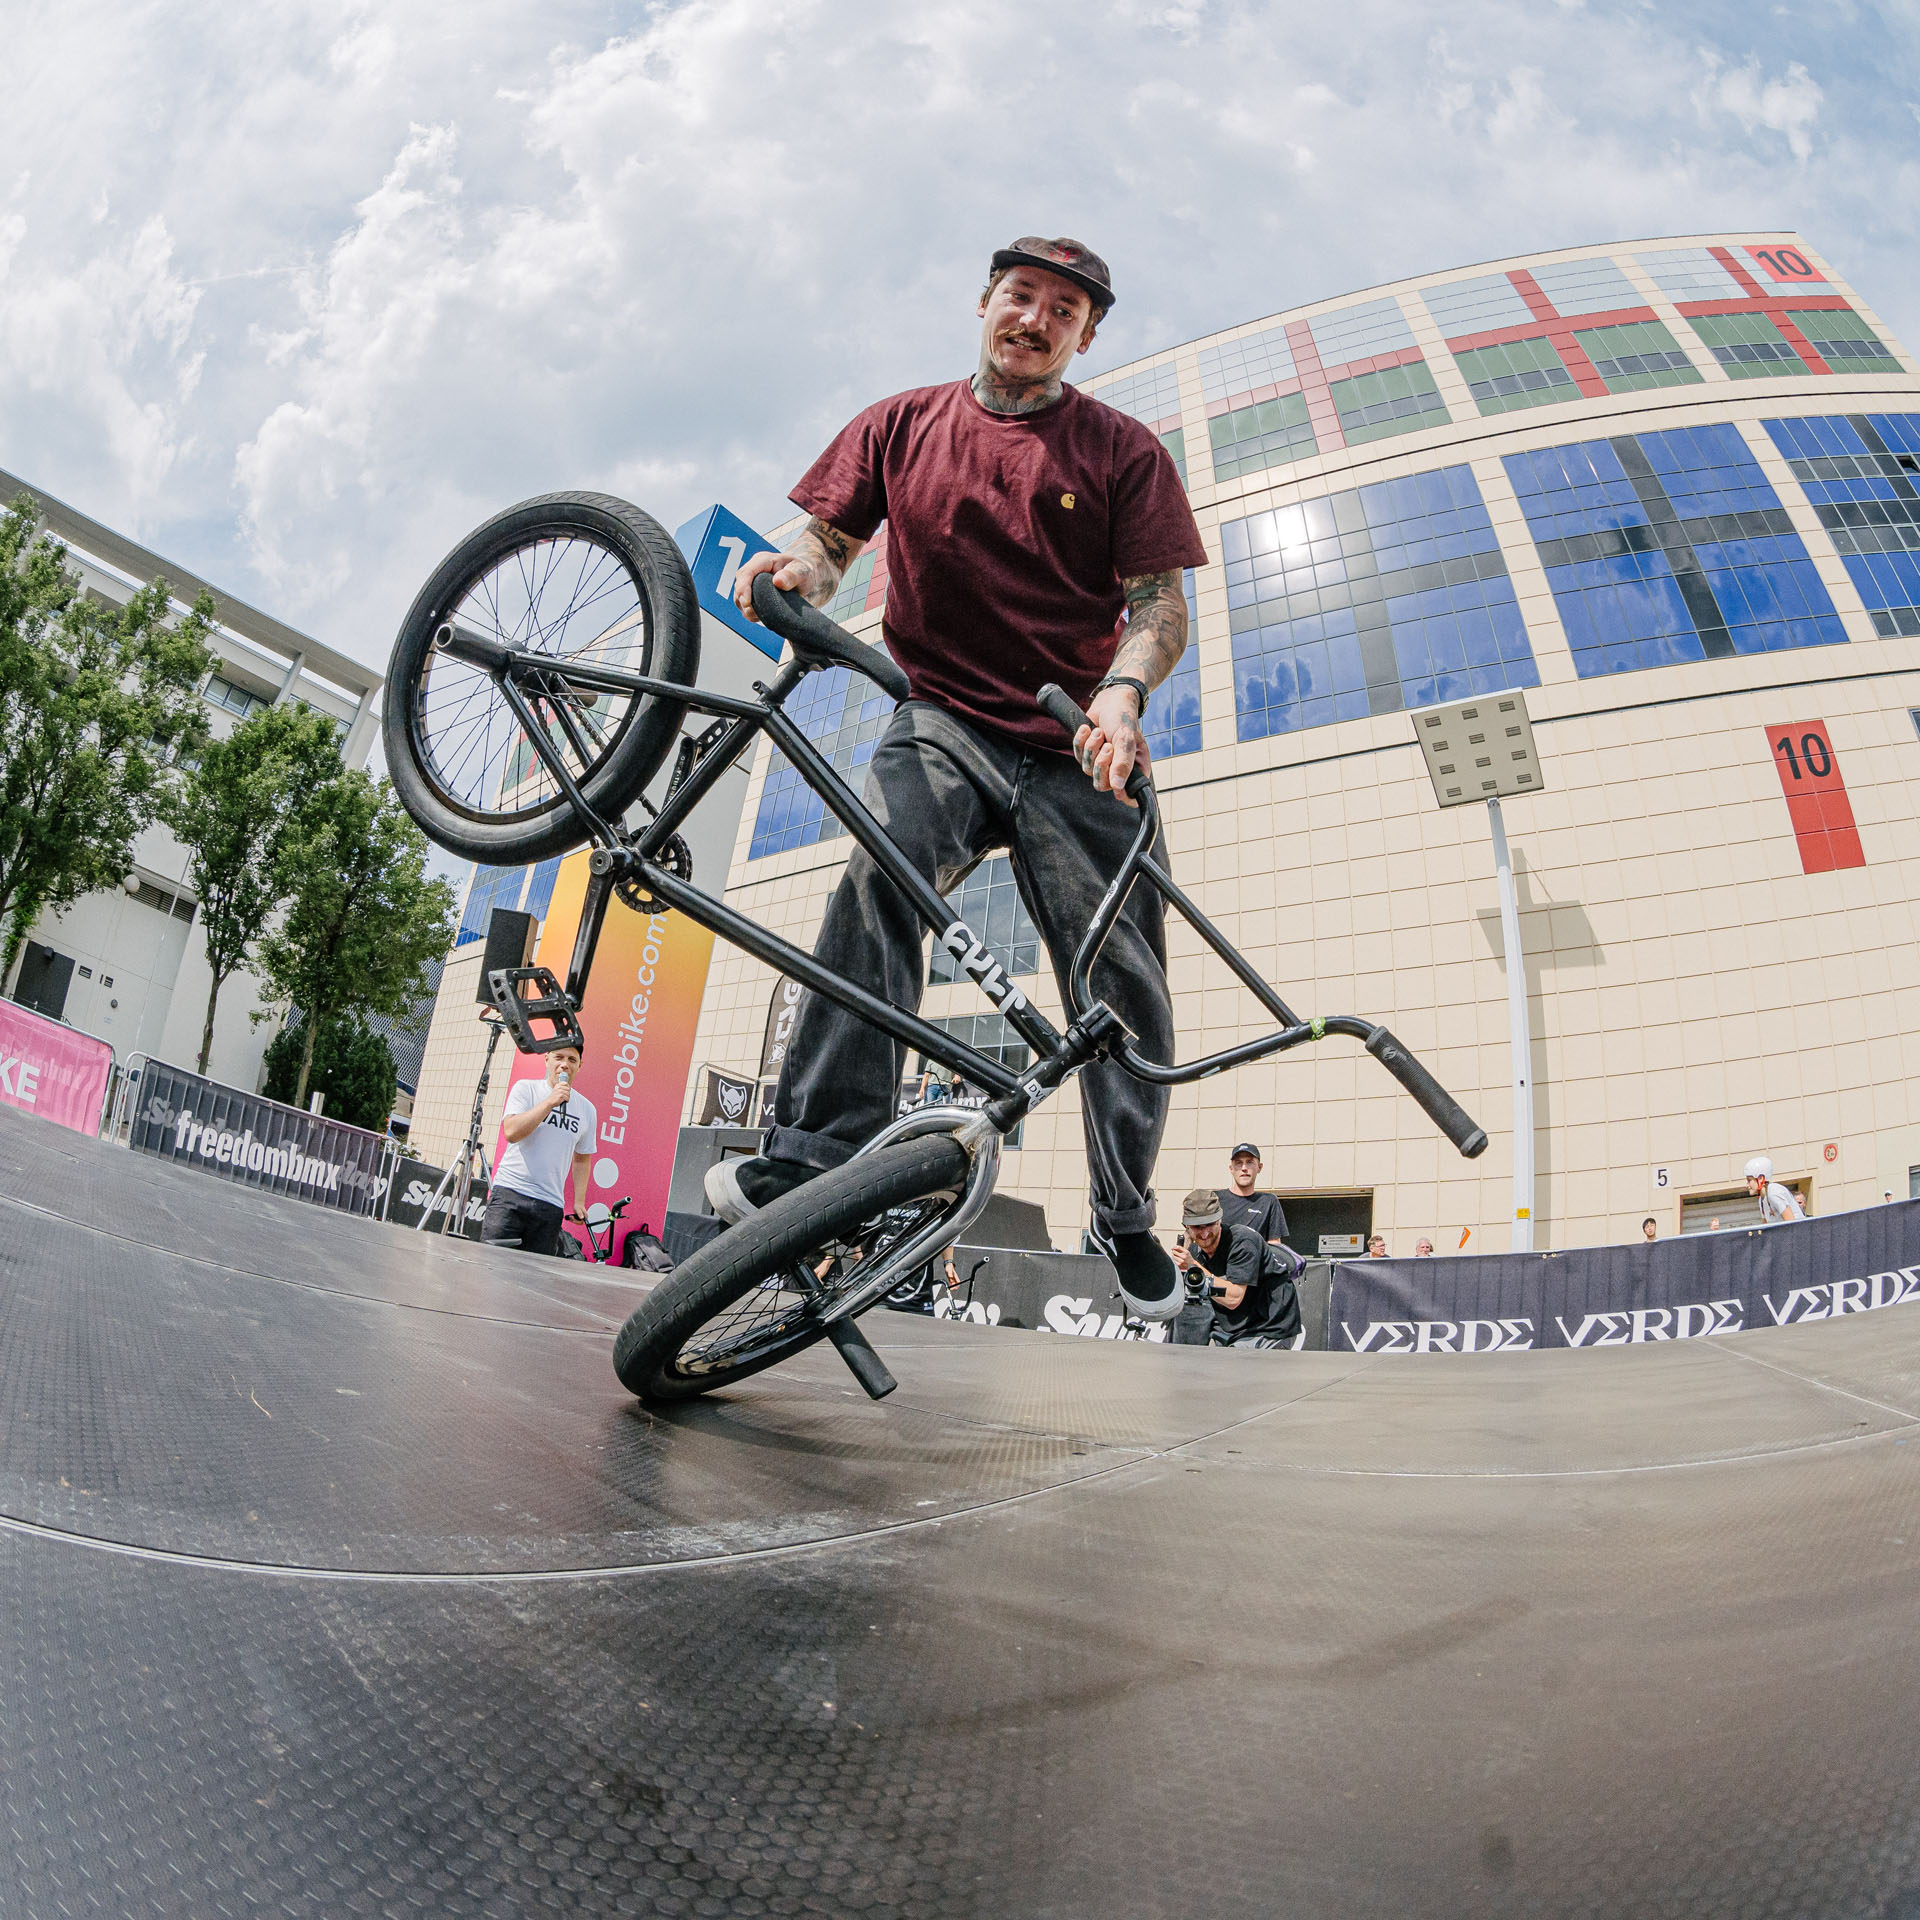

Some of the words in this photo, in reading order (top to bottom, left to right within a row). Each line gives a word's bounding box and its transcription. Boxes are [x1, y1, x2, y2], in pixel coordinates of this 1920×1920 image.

[1756, 250, 1813, 276] 10
[717, 536, 749, 601] 1
[1776, 733, 1832, 780] 10
[600, 913, 668, 1145] Eurobike.com
[175, 1110, 341, 1191] freedombmx
[1657, 1168, 1668, 1187] 5
